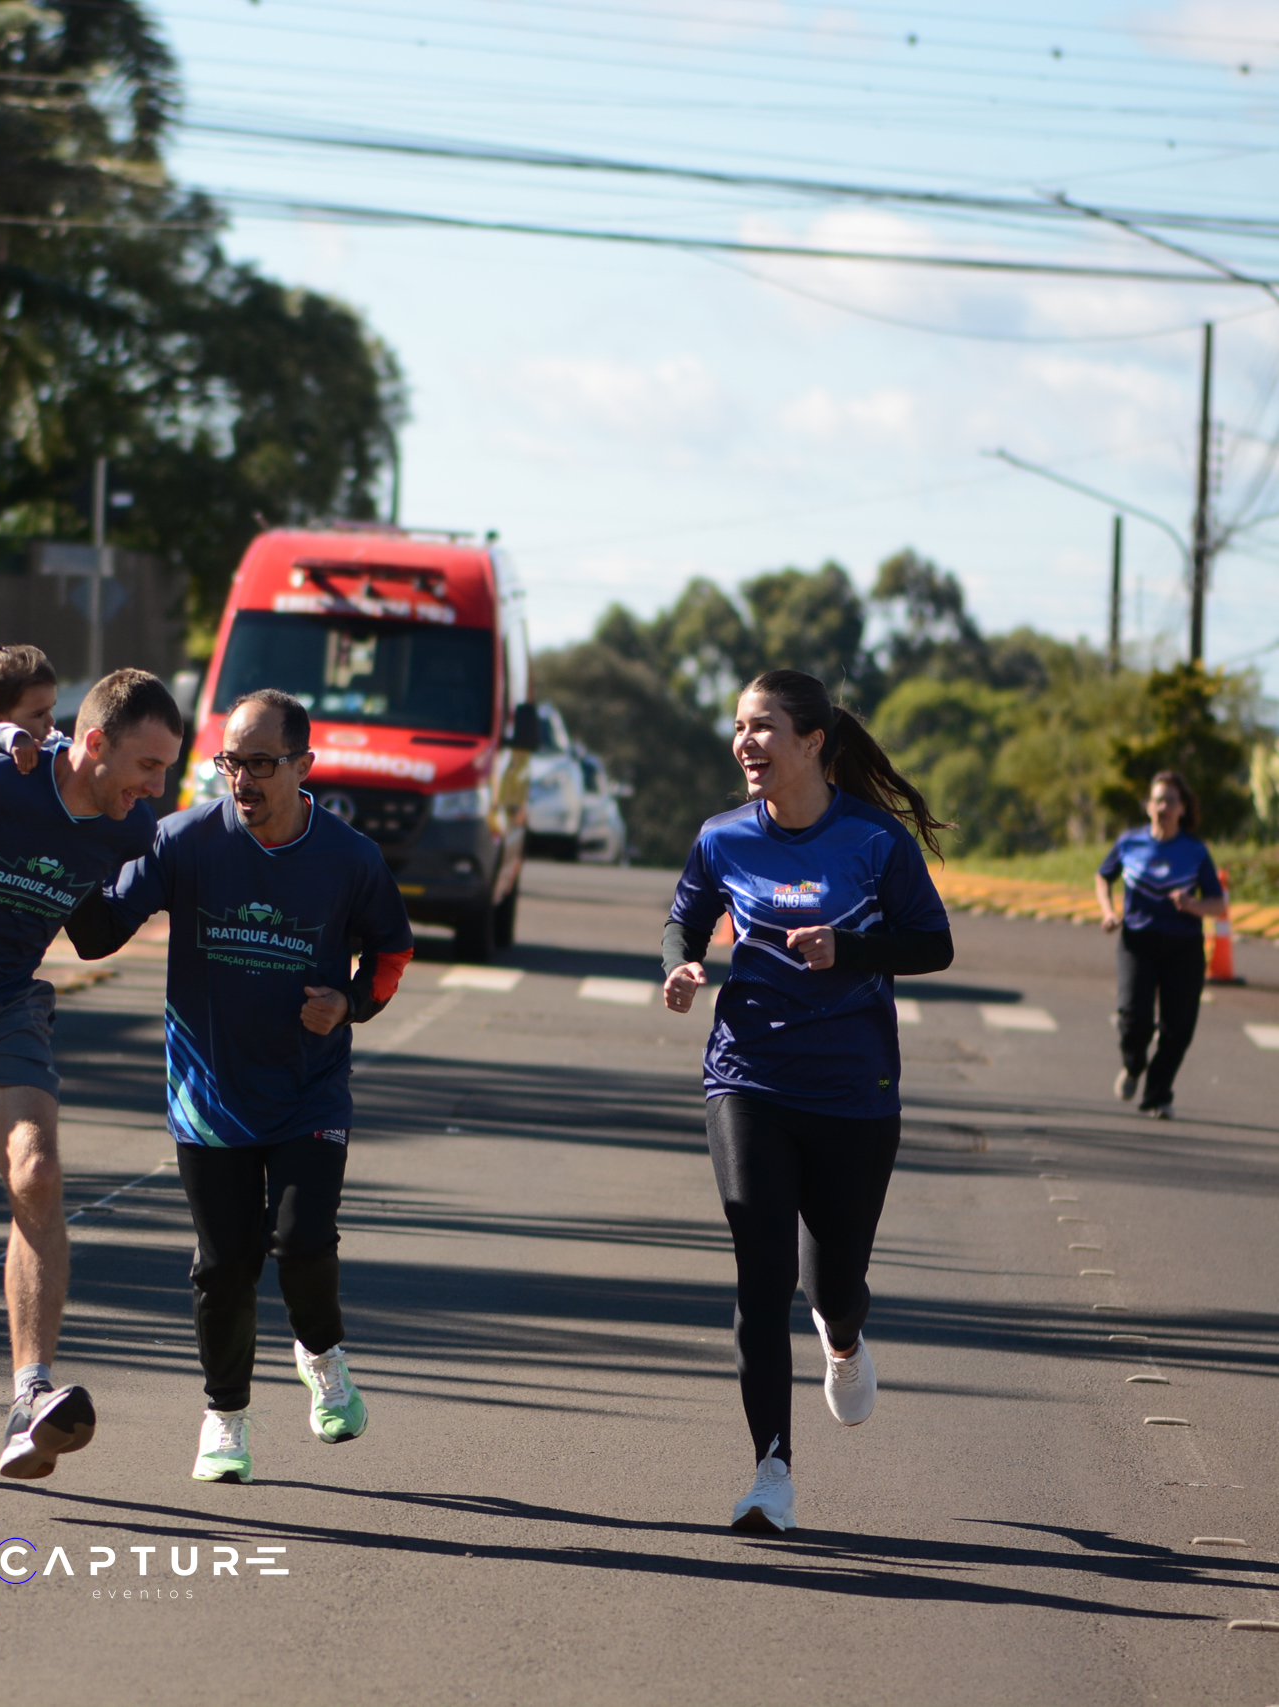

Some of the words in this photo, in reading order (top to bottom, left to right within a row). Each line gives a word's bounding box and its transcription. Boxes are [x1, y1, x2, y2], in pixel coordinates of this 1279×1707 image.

[43, 886, 77, 908] AJUDA
[772, 893, 800, 908] ONG
[269, 933, 314, 956] AJUDA
[207, 952, 244, 966] DUCAÇÃO
[245, 958, 272, 969] FÍSICA
[273, 962, 285, 970] EM
[286, 963, 306, 973] AÇÃO
